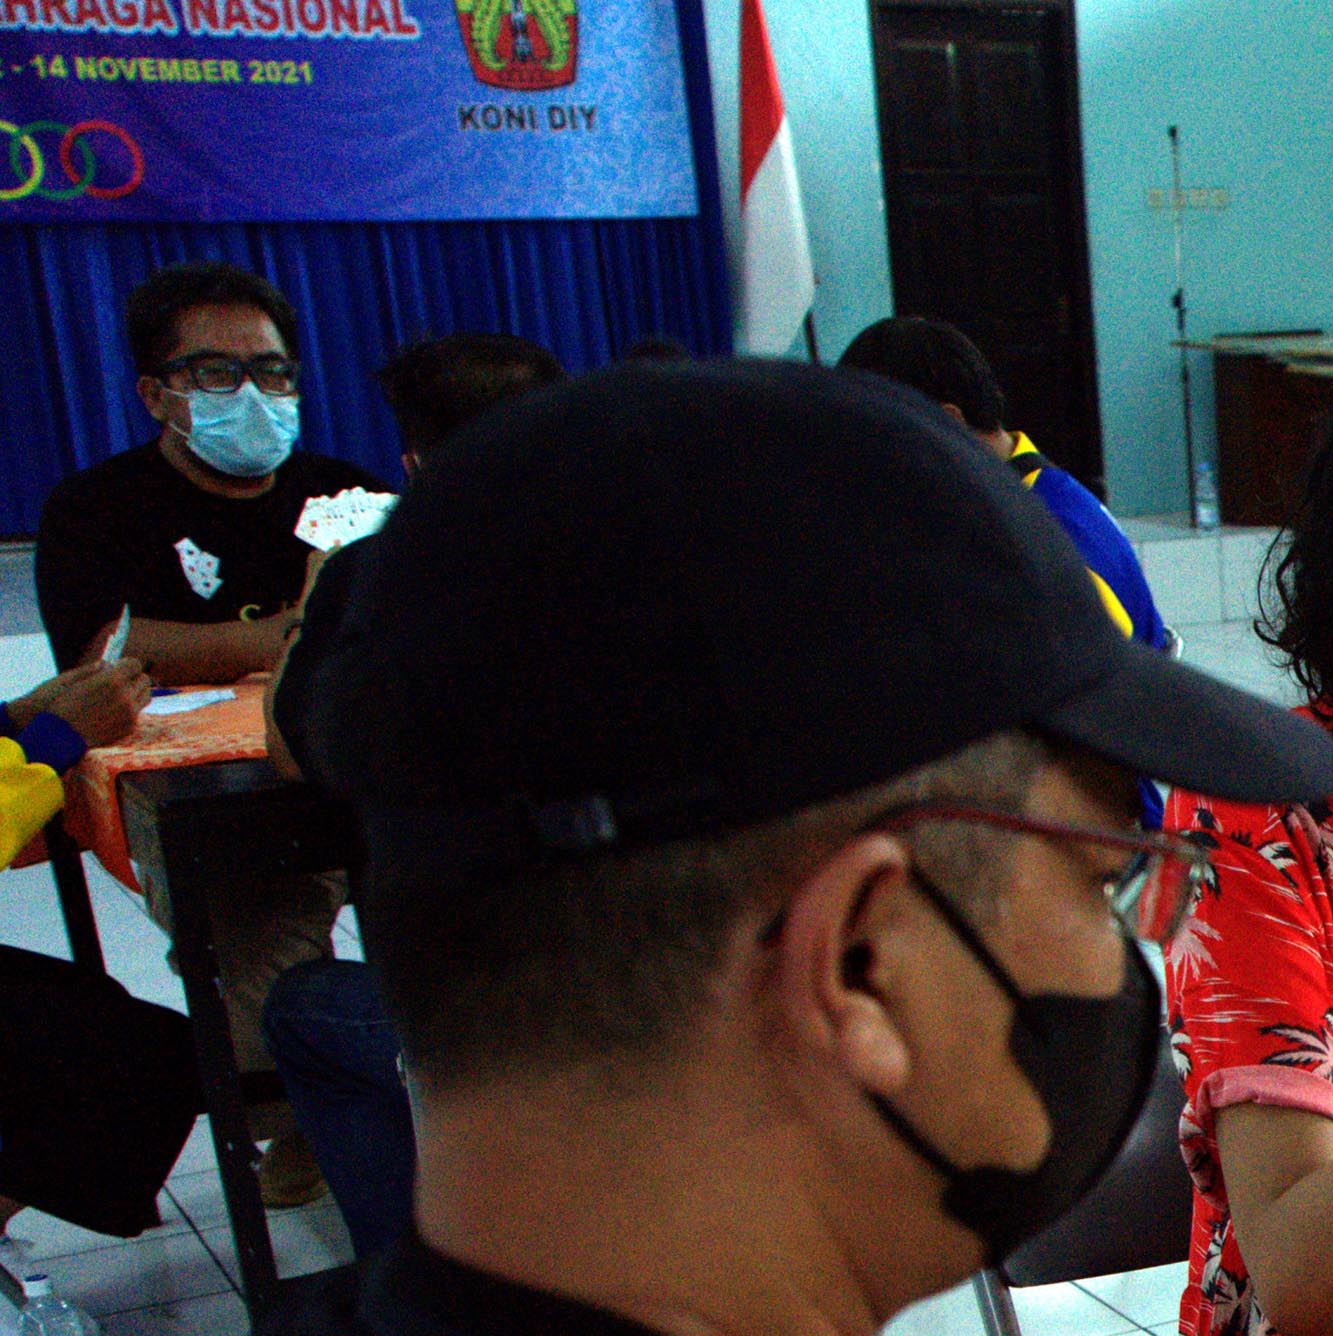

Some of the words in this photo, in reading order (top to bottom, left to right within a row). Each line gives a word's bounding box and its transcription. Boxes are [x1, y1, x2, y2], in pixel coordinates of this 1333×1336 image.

[187, 0, 422, 38] NASIONAL
[31, 54, 68, 79] 14
[75, 56, 241, 82] NOVEMBER
[249, 60, 313, 84] 2021
[458, 104, 536, 131] KONI
[548, 104, 597, 131] DIY
